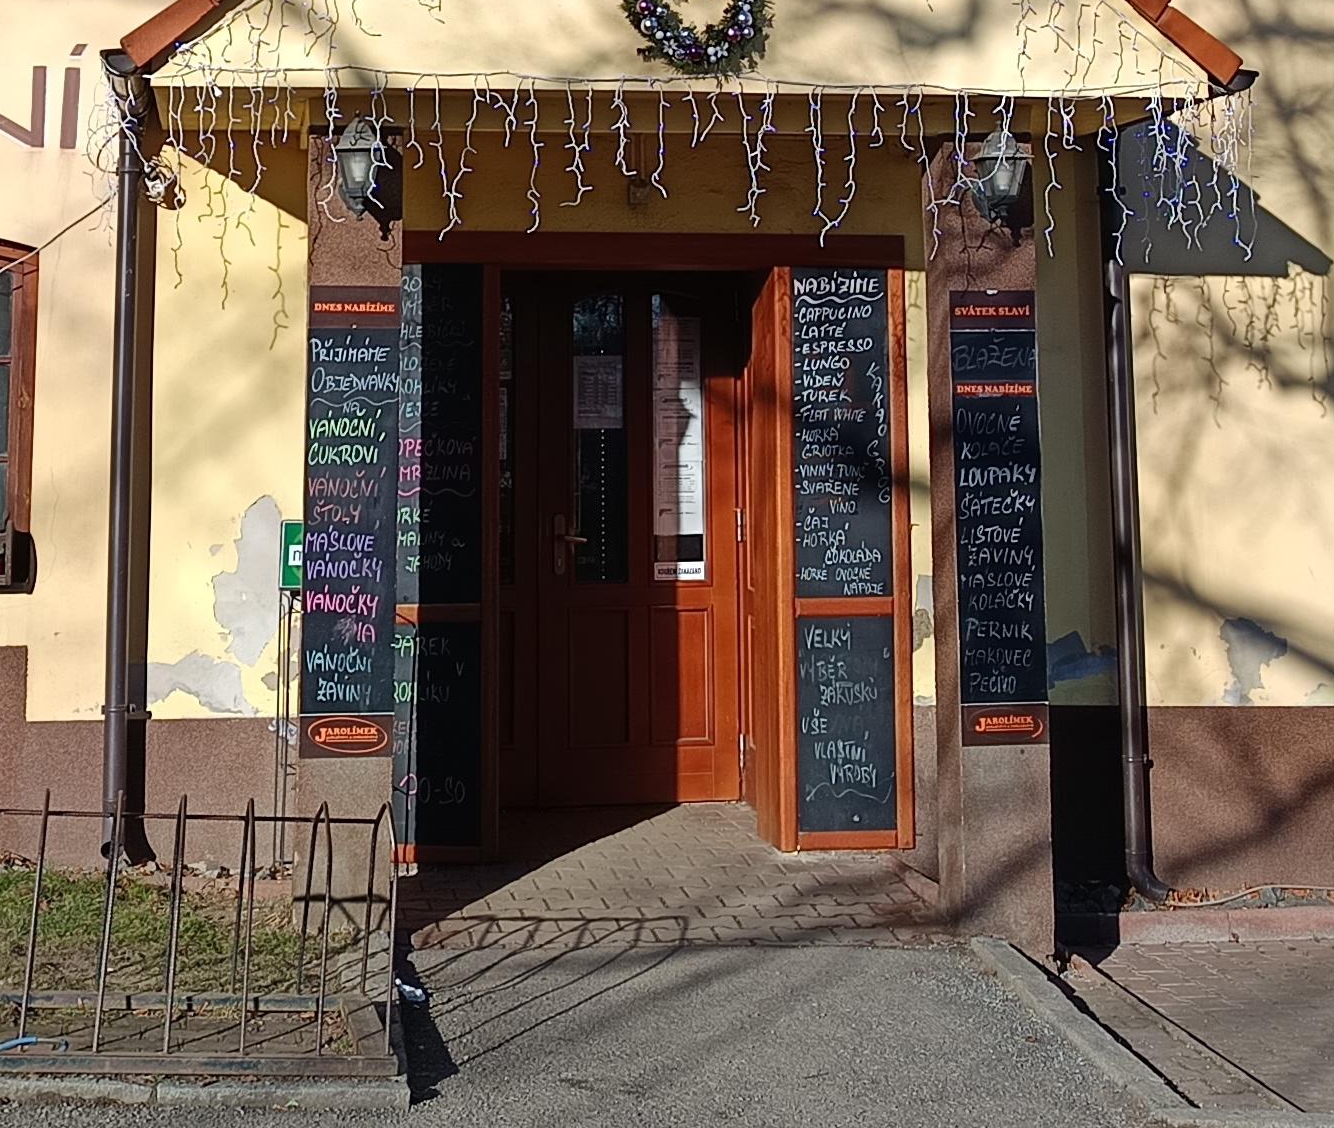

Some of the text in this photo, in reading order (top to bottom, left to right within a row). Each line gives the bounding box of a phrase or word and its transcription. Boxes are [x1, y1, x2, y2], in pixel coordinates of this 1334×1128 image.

[794, 271, 879, 295] NABÍZÍME
[314, 301, 395, 312] DNES NABÍZÍME
[955, 305, 1030, 316] SVÁTEK SLAVÍ
[310, 335, 390, 363] PŘIJÍMÁME
[953, 337, 1036, 371] BLAŽENA
[311, 366, 400, 395] OBJEDNÁVKY
[957, 383, 1033, 393] DNES NABÍZÍME
[309, 409, 382, 439] VÁNOČNÍ
[834, 407, 866, 422] WHITE
[956, 405, 1021, 435] OVOCNÉ
[801, 444, 855, 459] GRIOTKA
[308, 501, 361, 525] ŠTOLY
[830, 497, 856, 515] VÍNO
[960, 517, 1023, 545] LISTOVÉ
[306, 553, 382, 582] VÁNOČKY
[306, 584, 378, 618] VÁNOČKY
[804, 623, 851, 650] VELKÝ
[964, 647, 1032, 668] MAKOVEC
[315, 725, 378, 742] JAROLÍMEK
[975, 714, 1034, 732] JAROLÍMEK
